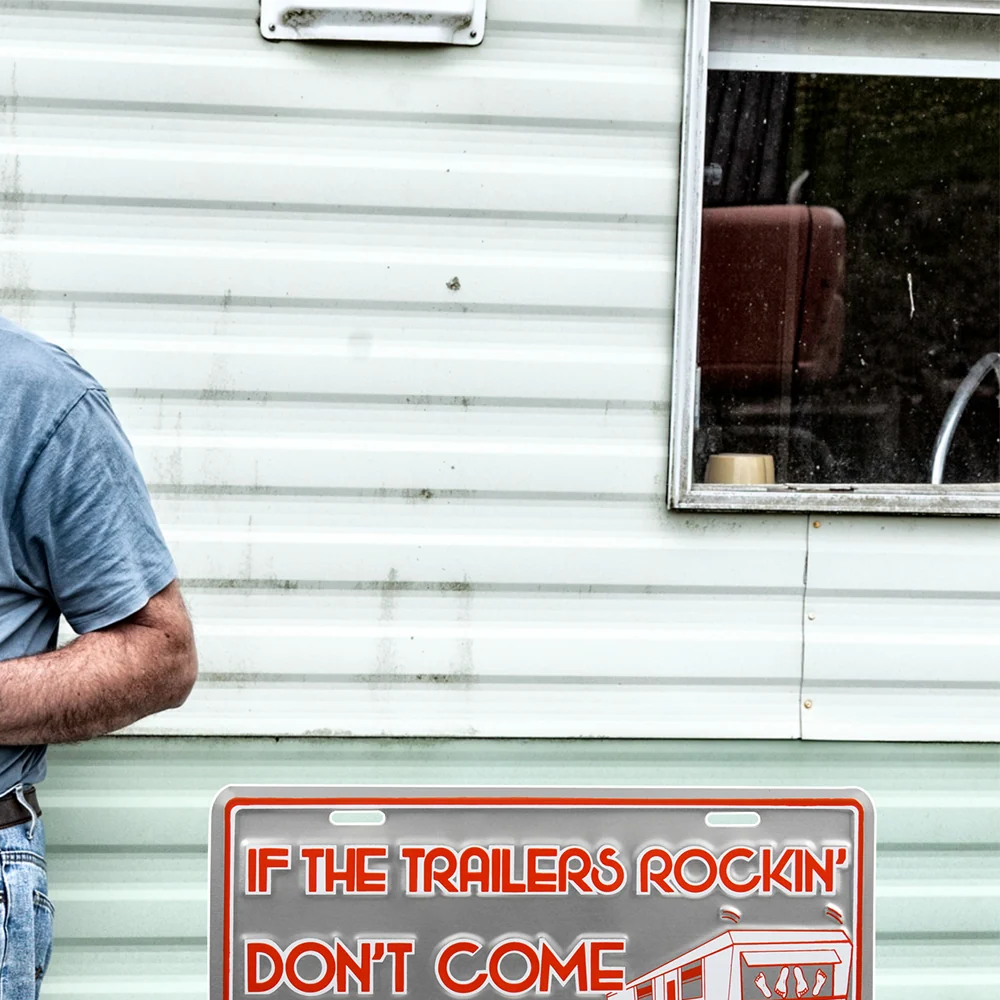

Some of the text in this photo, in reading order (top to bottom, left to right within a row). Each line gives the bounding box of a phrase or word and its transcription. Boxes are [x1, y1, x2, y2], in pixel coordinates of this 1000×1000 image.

[247, 846, 847, 893] IF THE TRAILERS ROCKIN'
[246, 940, 633, 993] DON'T COME
